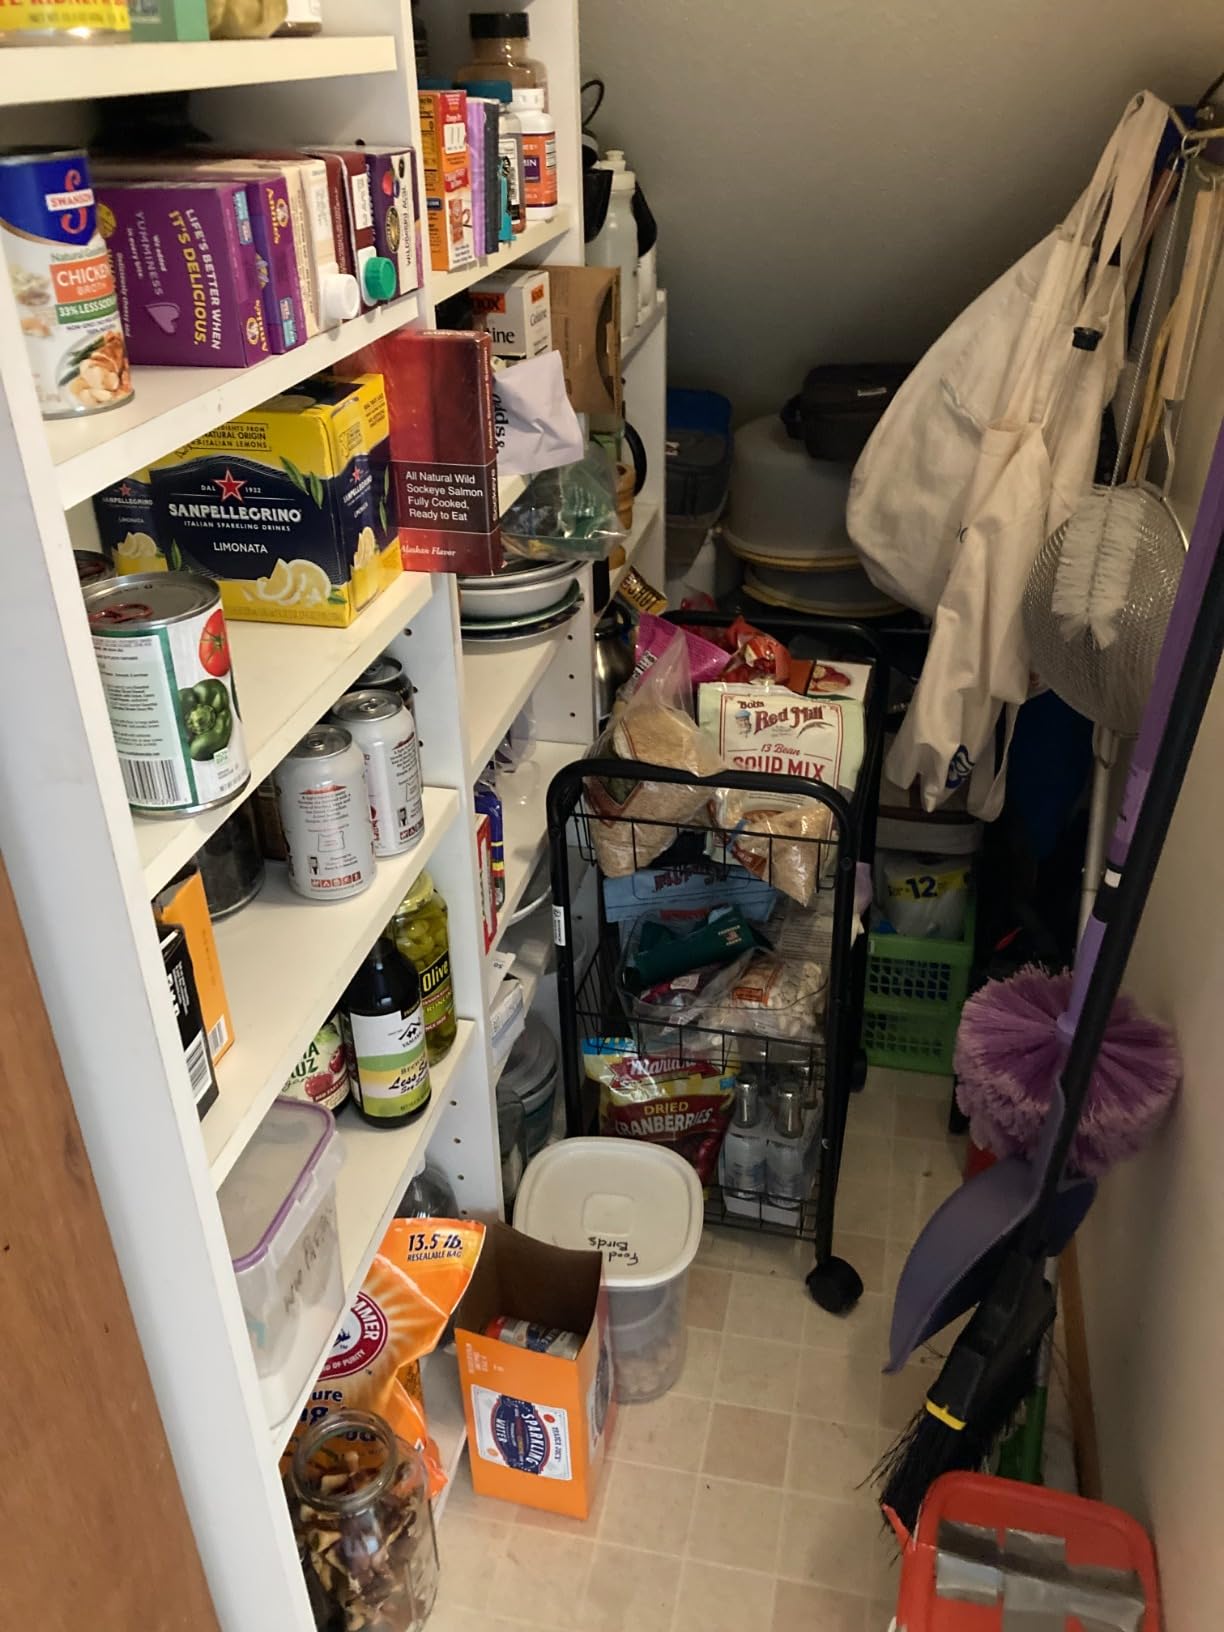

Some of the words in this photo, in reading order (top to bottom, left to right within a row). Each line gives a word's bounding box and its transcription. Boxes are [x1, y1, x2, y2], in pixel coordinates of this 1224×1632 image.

[168, 210, 192, 244] IT'S
[185, 208, 210, 252] LIFE'S
[136, 211, 164, 296] YUMMINESS
[202, 253, 221, 306] BETTER
[58, 304, 79, 317] 33%
[211, 309, 222, 350] WHEN
[237, 431, 266, 441] ORIGIN
[405, 471, 418, 480] All
[419, 471, 453, 483] Natural
[454, 473, 476, 484] Wild
[200, 484, 217, 492] DAL
[406, 483, 446, 496] Sockeye
[447, 486, 484, 497] Salmon
[407, 495, 430, 508] Fully
[431, 497, 470, 510] Cooked,
[168, 503, 301, 523] SANPELLEGRINO
[409, 508, 439, 521] Ready
[440, 511, 450, 520] to
[451, 511, 468, 521] Eat
[184, 520, 214, 528] ITALIAN
[216, 522, 259, 530] SPARKLING
[261, 524, 291, 532] DRINKS
[213, 542, 269, 554] LIMONATA
[753, 707, 789, 736] Red
[789, 705, 824, 729] Mill
[761, 743, 773, 753] 13
[774, 743, 801, 756] Bean
[787, 758, 826, 780] MIX
[905, 876, 938, 899] 12
[422, 960, 449, 992] Olive
[388, 1072, 417, 1090] Less
[643, 1101, 689, 1116] DRIED
[615, 1107, 713, 1136] CRANBERRIES
[408, 1233, 440, 1252] 13.5
[442, 1233, 463, 1250] lb.
[588, 1236, 628, 1251] Birds
[407, 1250, 445, 1262] RESEALABLE
[608, 1251, 639, 1266] Food
[332, 1360, 341, 1370] OF
[342, 1348, 367, 1367] PURITY
[312, 1389, 343, 1402] ure
[495, 1418, 508, 1443] WATER
[521, 1413, 546, 1466] SPARKLING
